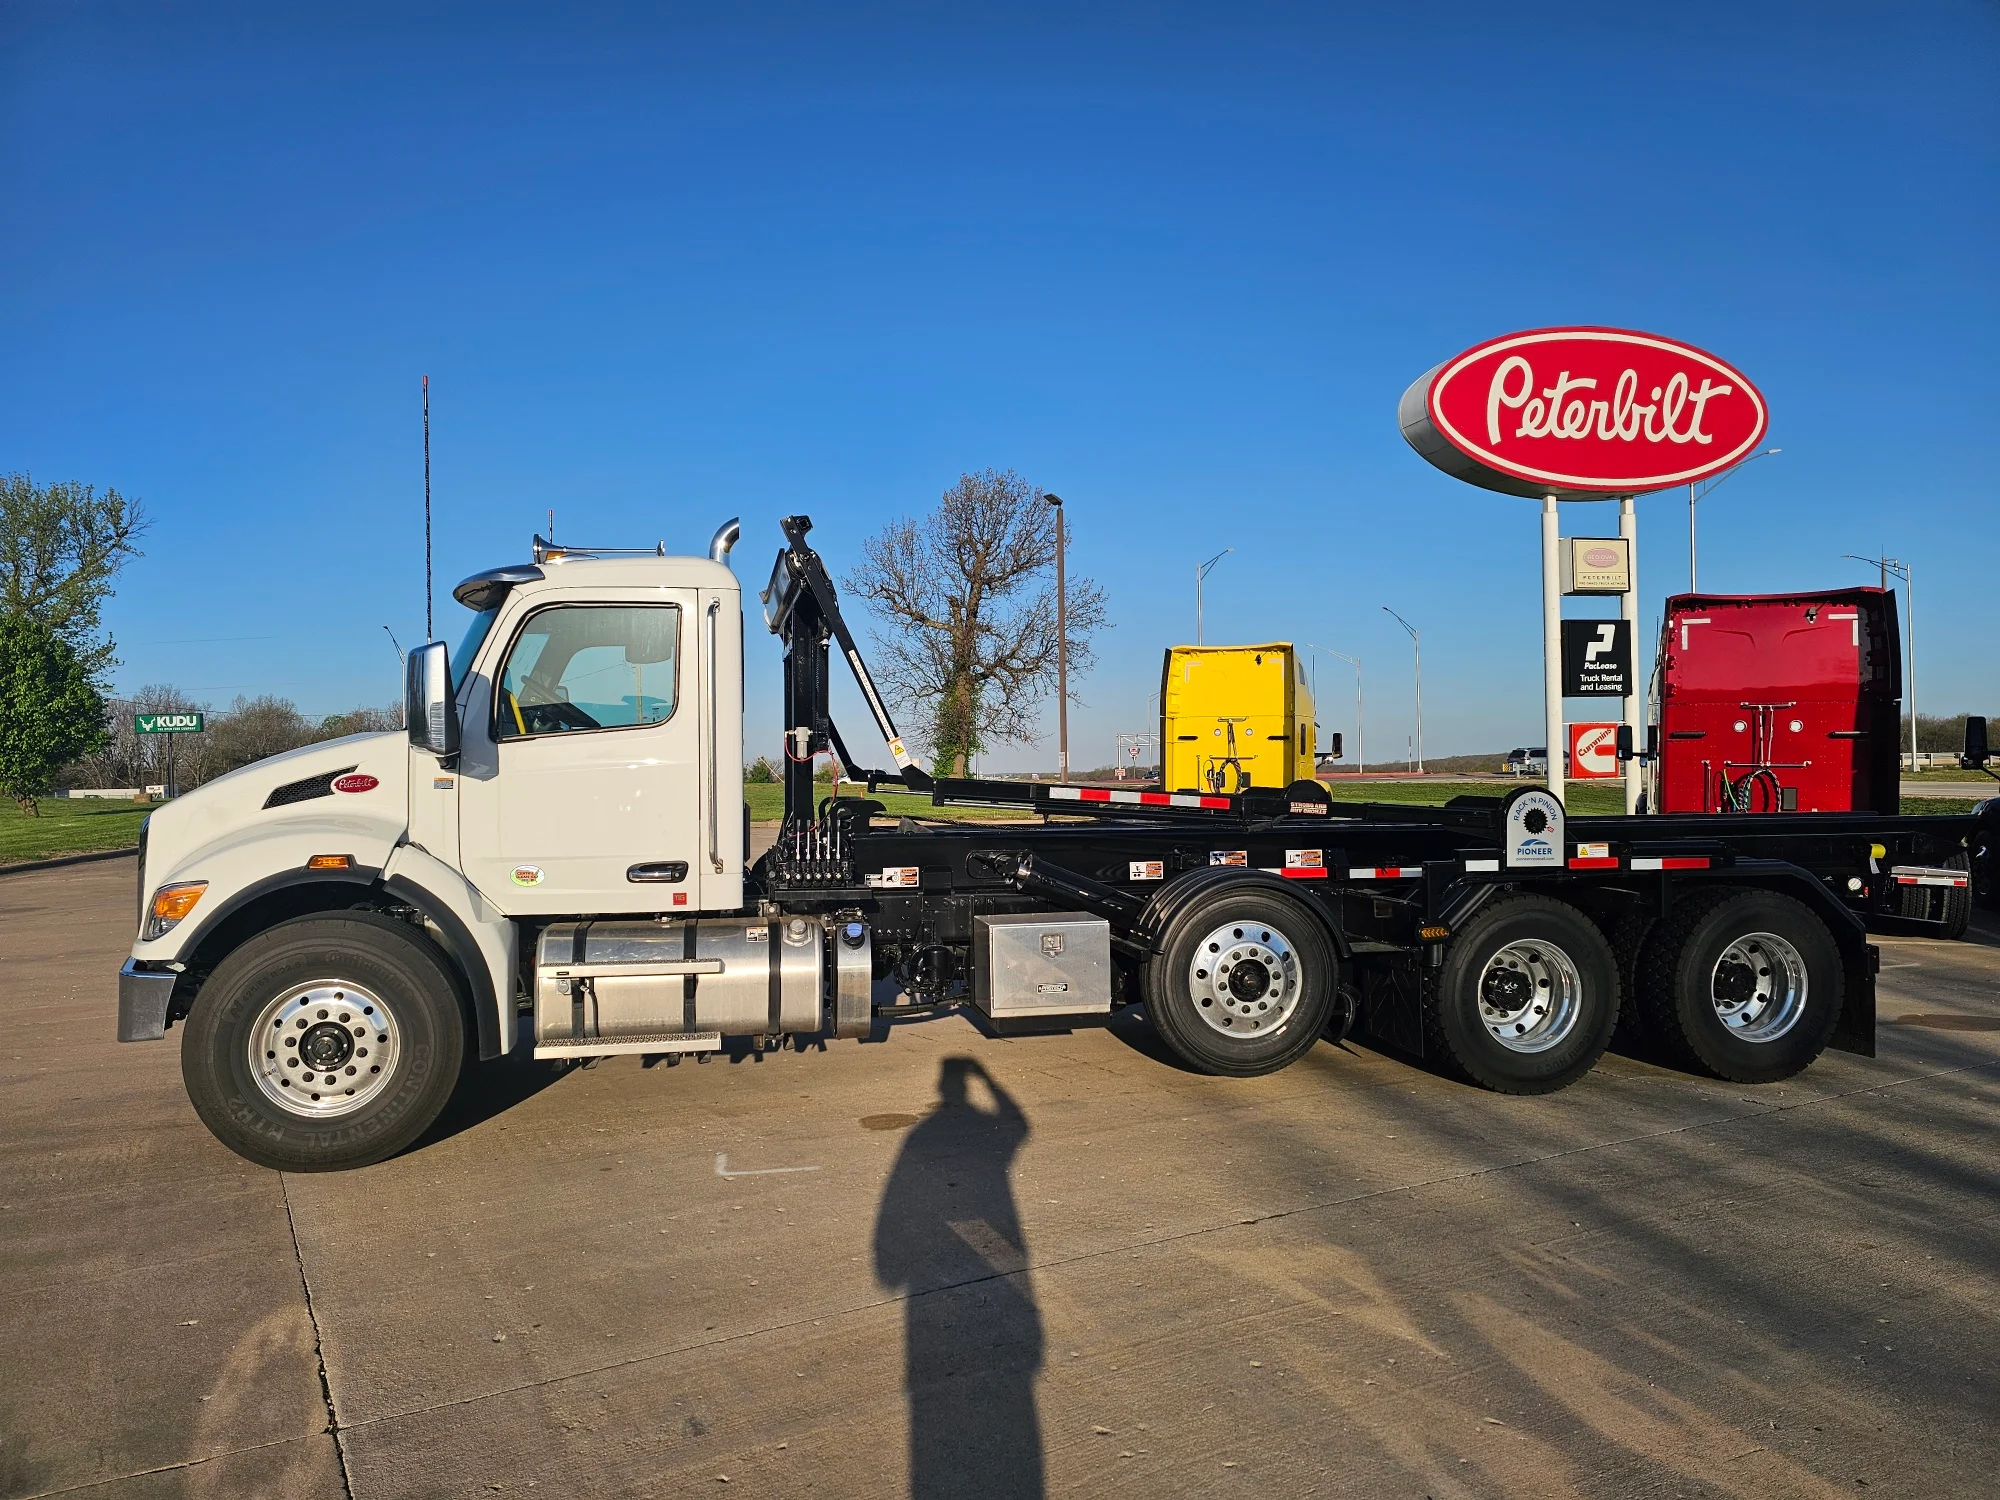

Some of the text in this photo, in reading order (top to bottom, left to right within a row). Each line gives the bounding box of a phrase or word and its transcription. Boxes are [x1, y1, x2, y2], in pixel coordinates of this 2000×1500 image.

[1487, 355, 1732, 446] Peterbilt
[1584, 661, 1617, 670] PacLease
[1580, 673, 1623, 682] Truck Rental
[1580, 682, 1623, 692] and Leasing
[157, 715, 197, 727] KUDU
[1578, 728, 1612, 757] Cummins
[339, 778, 374, 790] Peterbilt
[1513, 800, 1528, 821] RACK
[1538, 798, 1558, 821] PINION
[304, 1044, 431, 1147] CONTINENTAL
